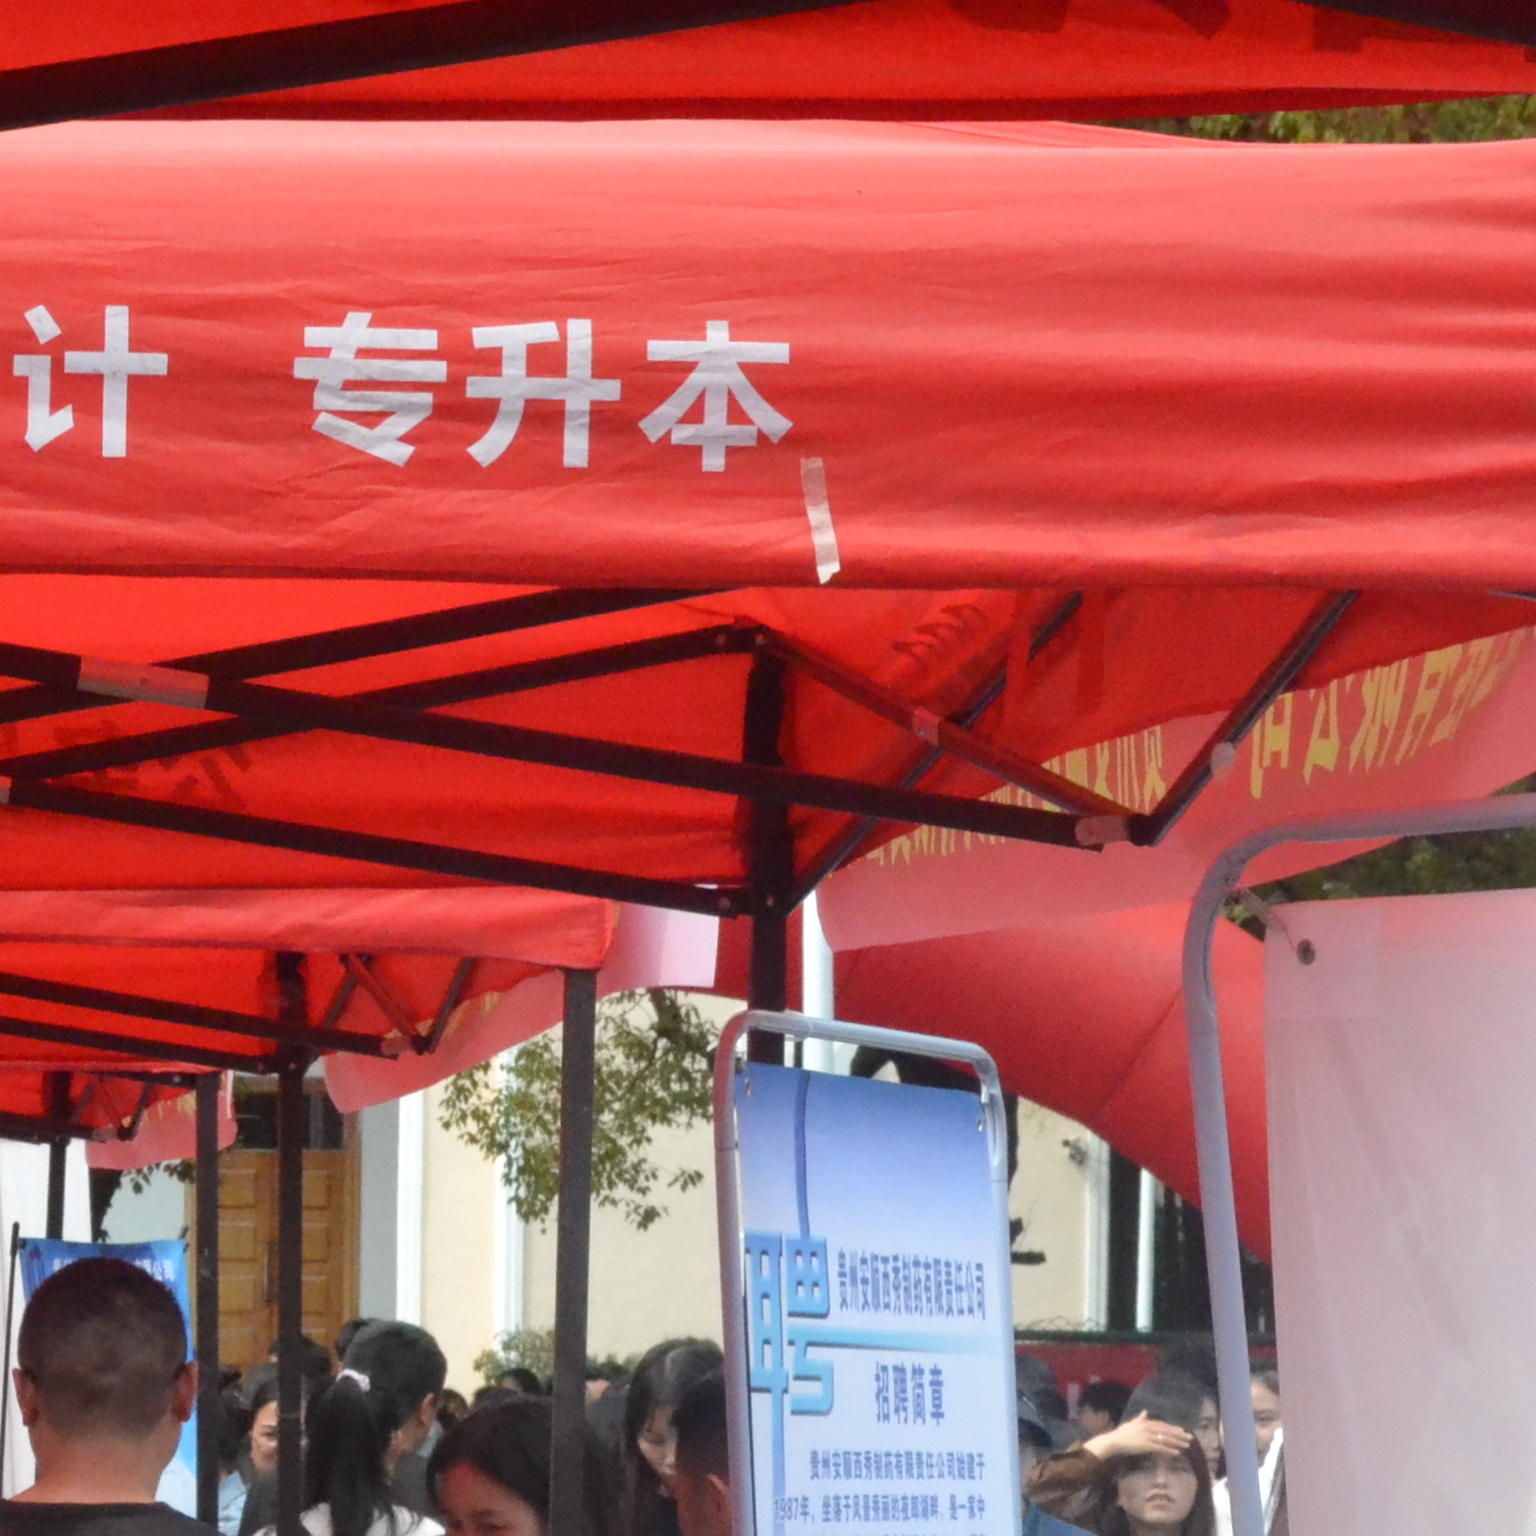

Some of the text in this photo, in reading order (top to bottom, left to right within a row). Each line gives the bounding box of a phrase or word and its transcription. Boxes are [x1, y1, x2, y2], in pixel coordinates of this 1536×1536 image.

[293, 312, 793, 474] 专升本
[874, 1361, 945, 1427] 招聘简章
